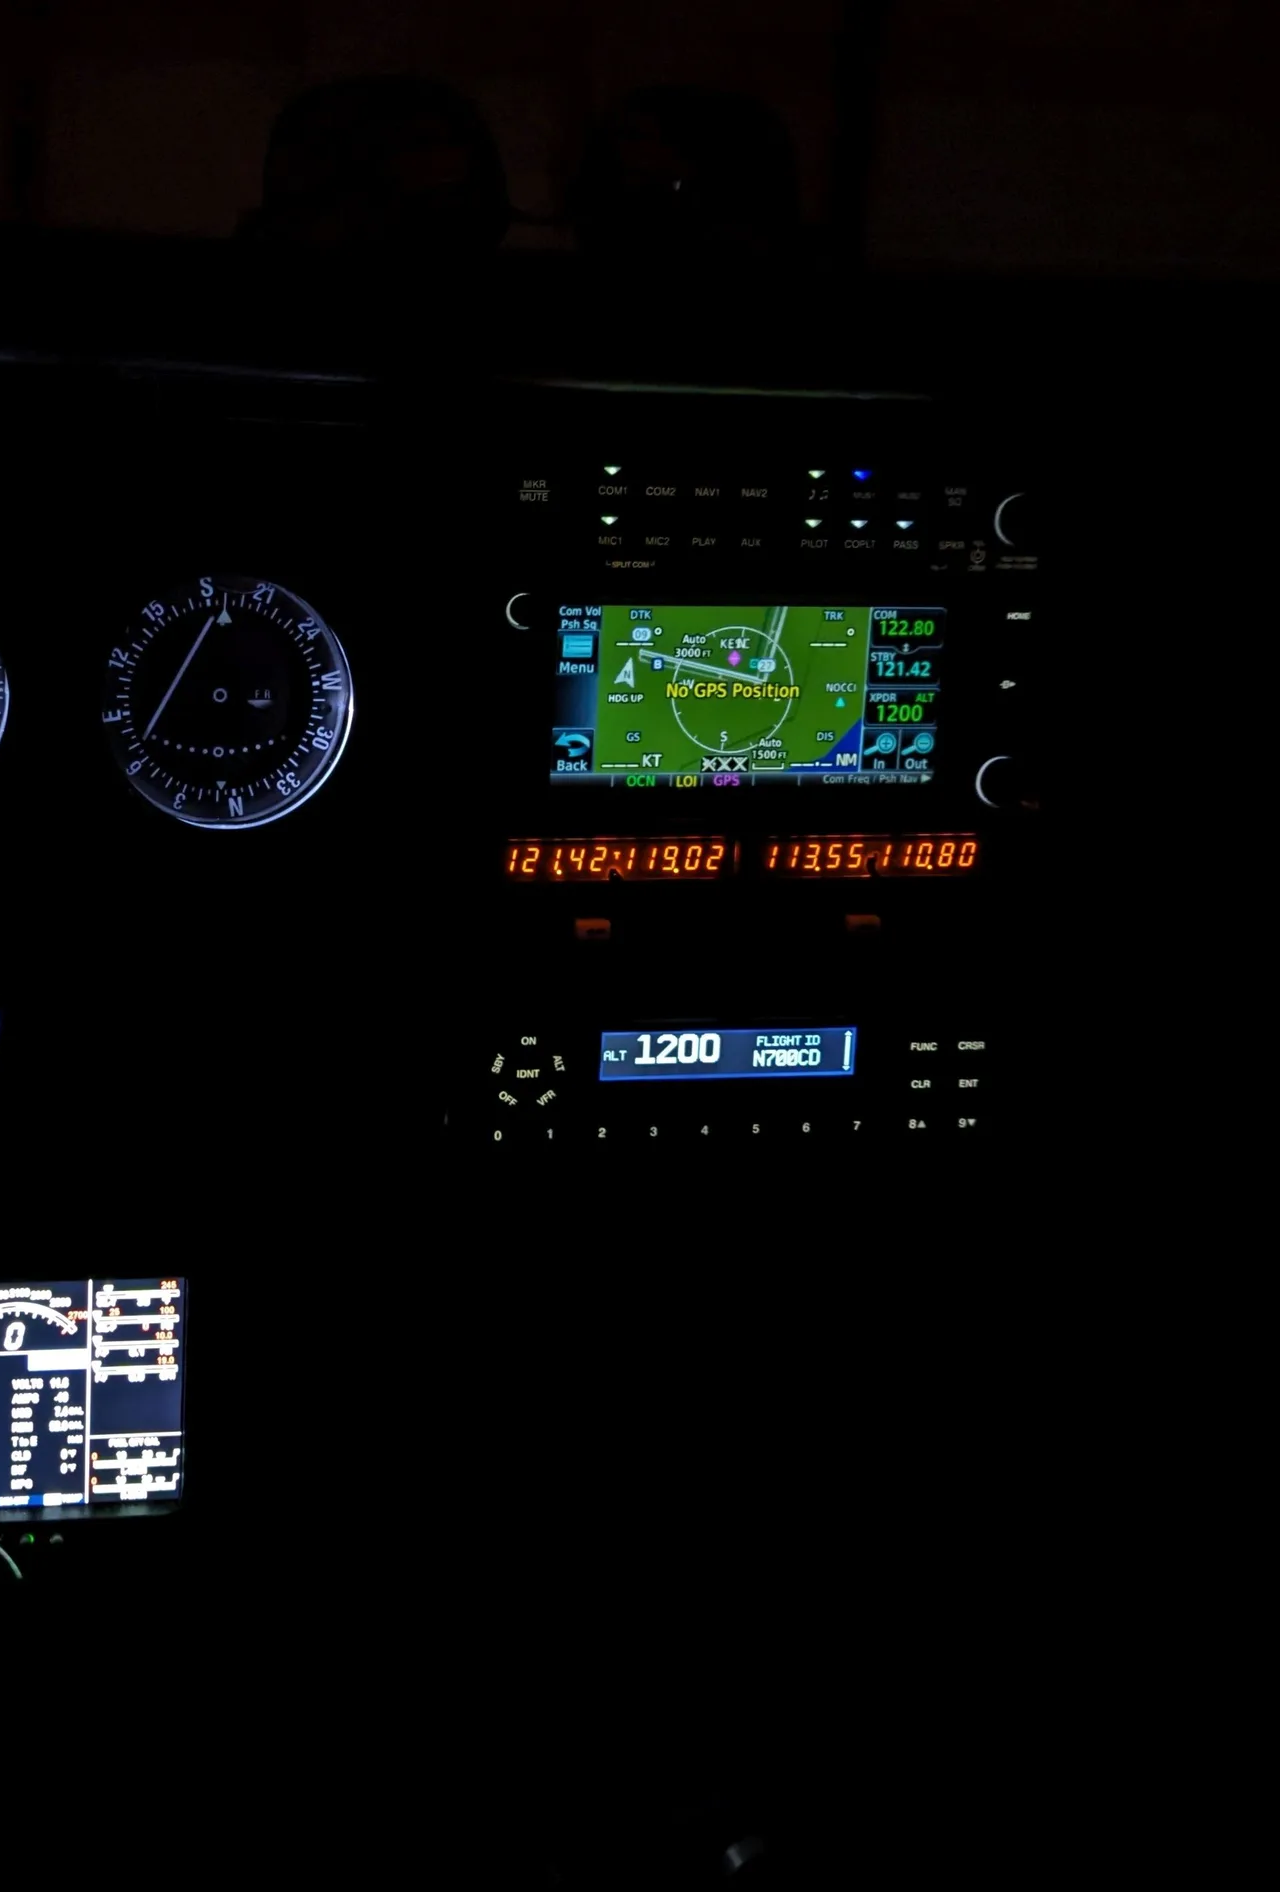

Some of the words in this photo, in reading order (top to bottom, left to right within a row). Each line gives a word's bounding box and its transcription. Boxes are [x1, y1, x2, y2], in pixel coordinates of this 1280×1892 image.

[598, 485, 627, 496] COM1
[645, 486, 677, 497] COM2
[695, 488, 720, 498] NAV1
[692, 537, 717, 547] PLAY
[800, 539, 828, 549] PILOT
[893, 540, 920, 550] PASS
[199, 577, 215, 598] S
[252, 583, 276, 605] 21
[141, 600, 166, 622] 15
[558, 605, 582, 616] Com
[585, 605, 602, 616] Vol
[629, 609, 652, 620] DTK
[824, 610, 844, 621] TRK
[873, 610, 898, 620] COM
[297, 616, 322, 641] 24
[560, 619, 580, 630] Psh
[879, 620, 935, 636] 122.80
[682, 634, 707, 645] Auto
[108, 647, 130, 669] 12
[674, 648, 701, 658] 3000
[870, 652, 897, 662] STBY
[558, 661, 595, 674] Menu
[876, 661, 932, 677] 121.42
[321, 669, 343, 691] W
[666, 683, 689, 698] No
[693, 683, 727, 698] GPS
[732, 683, 800, 698] Position
[608, 694, 629, 703] HDG
[630, 694, 644, 703] UP
[869, 693, 897, 703] XPDR
[915, 692, 935, 702] ALT
[102, 708, 122, 723] E
[876, 704, 923, 723] 1200
[312, 726, 334, 750] 30
[626, 732, 641, 742] GS
[816, 731, 834, 742] DIS
[758, 738, 783, 748] Auto
[642, 754, 663, 767] KT
[751, 749, 777, 760] 1500
[556, 759, 588, 772] Back
[873, 758, 886, 770] In
[904, 758, 928, 770] Out
[276, 771, 301, 796] 33
[626, 775, 656, 788] OCN
[676, 775, 698, 788] LOI
[713, 774, 741, 787] GPS
[822, 774, 845, 784] Com
[847, 774, 871, 785] Freq
[878, 774, 897, 784] Psh
[899, 774, 919, 784] Nav
[173, 793, 187, 810] 3
[228, 796, 244, 817] N
[521, 1036, 537, 1046] ON
[756, 1035, 803, 1047] FLIGHT
[805, 1035, 820, 1046] ID
[910, 1041, 938, 1051] FUNC
[958, 1041, 986, 1051] CRSR
[634, 1033, 721, 1065] 1200
[603, 1050, 628, 1062] ALT
[753, 1049, 821, 1067] N700CD
[491, 1053, 506, 1075] SBY
[552, 1054, 565, 1073] ALT
[516, 1068, 540, 1079] IDNT
[911, 1079, 931, 1089] CLR
[958, 1079, 979, 1089] ENT
[498, 1090, 518, 1107] OFF
[536, 1089, 557, 1107] VFR
[546, 1128, 554, 1139] 1
[161, 1280, 177, 1289] 245
[160, 1305, 175, 1315] 100
[3, 1321, 26, 1351] 0
[155, 1331, 173, 1340] 10.0
